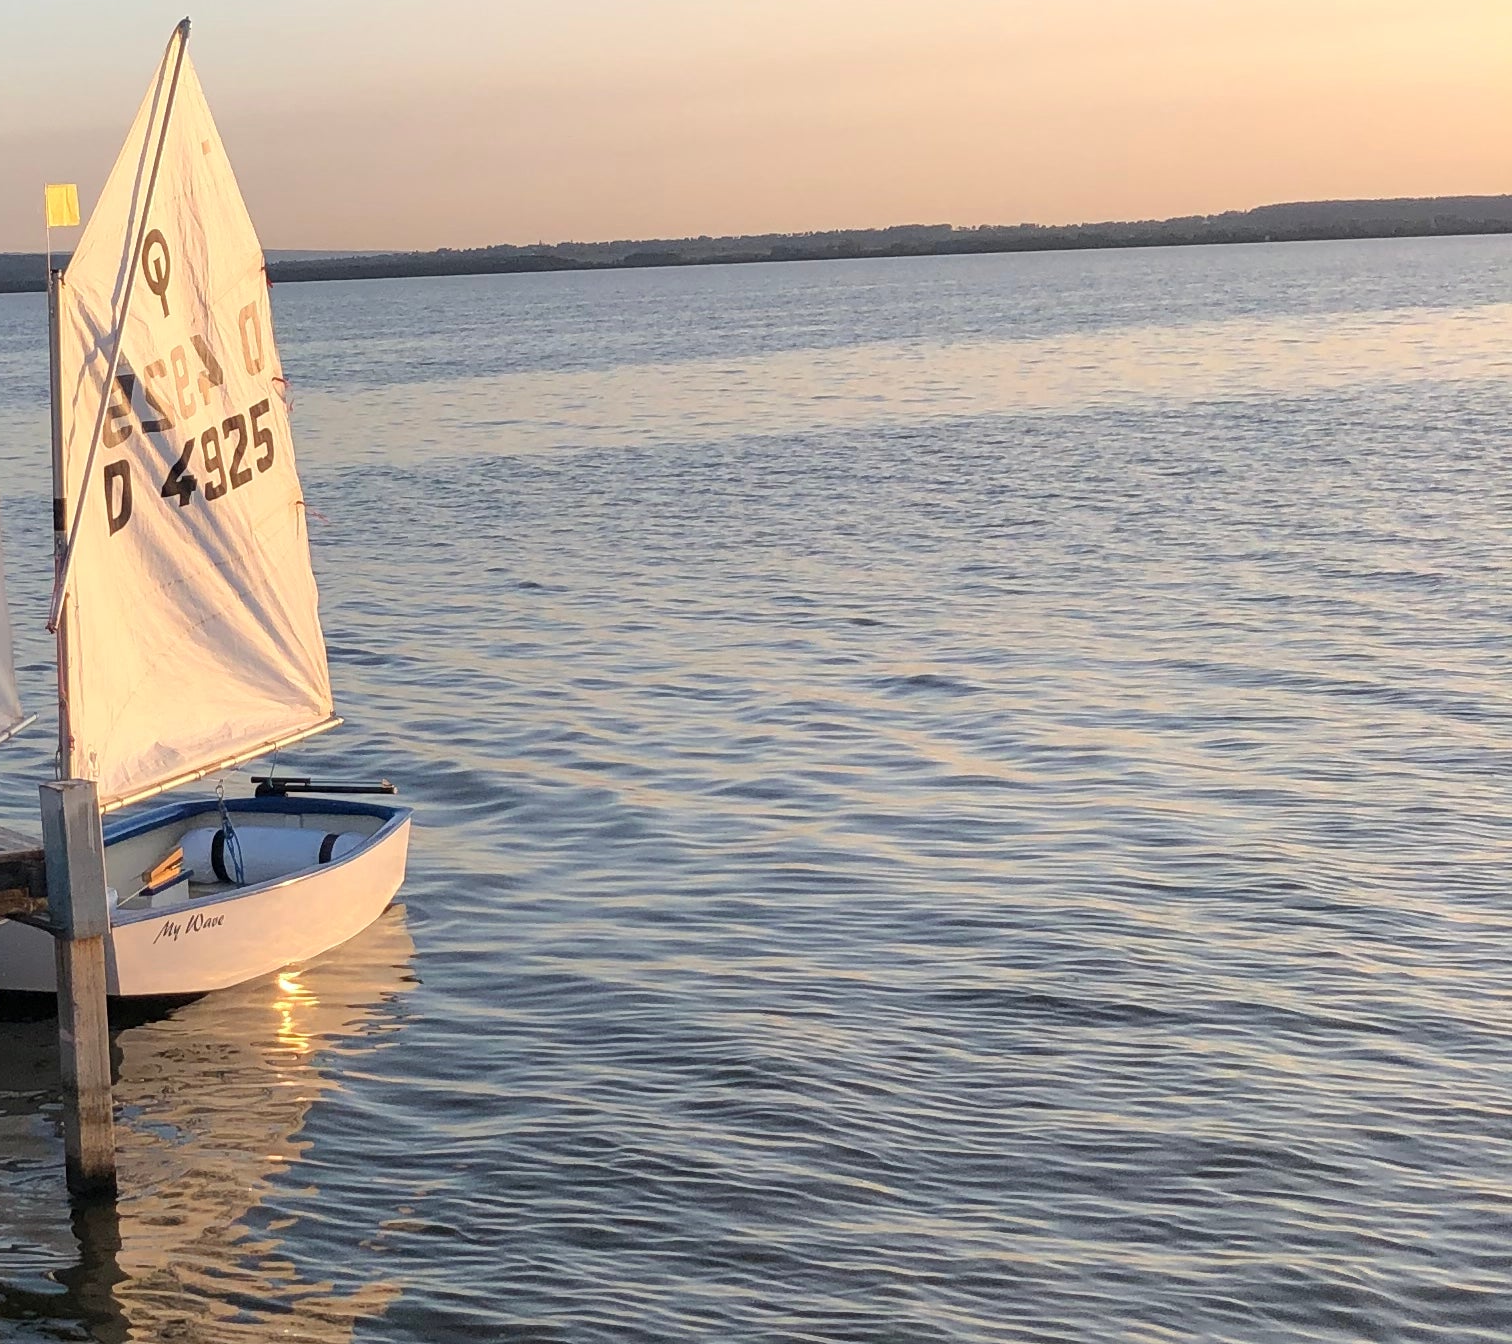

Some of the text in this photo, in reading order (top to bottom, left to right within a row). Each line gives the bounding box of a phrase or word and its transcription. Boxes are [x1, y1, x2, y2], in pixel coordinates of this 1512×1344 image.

[104, 398, 275, 537] D 4925
[153, 920, 182, 945] My
